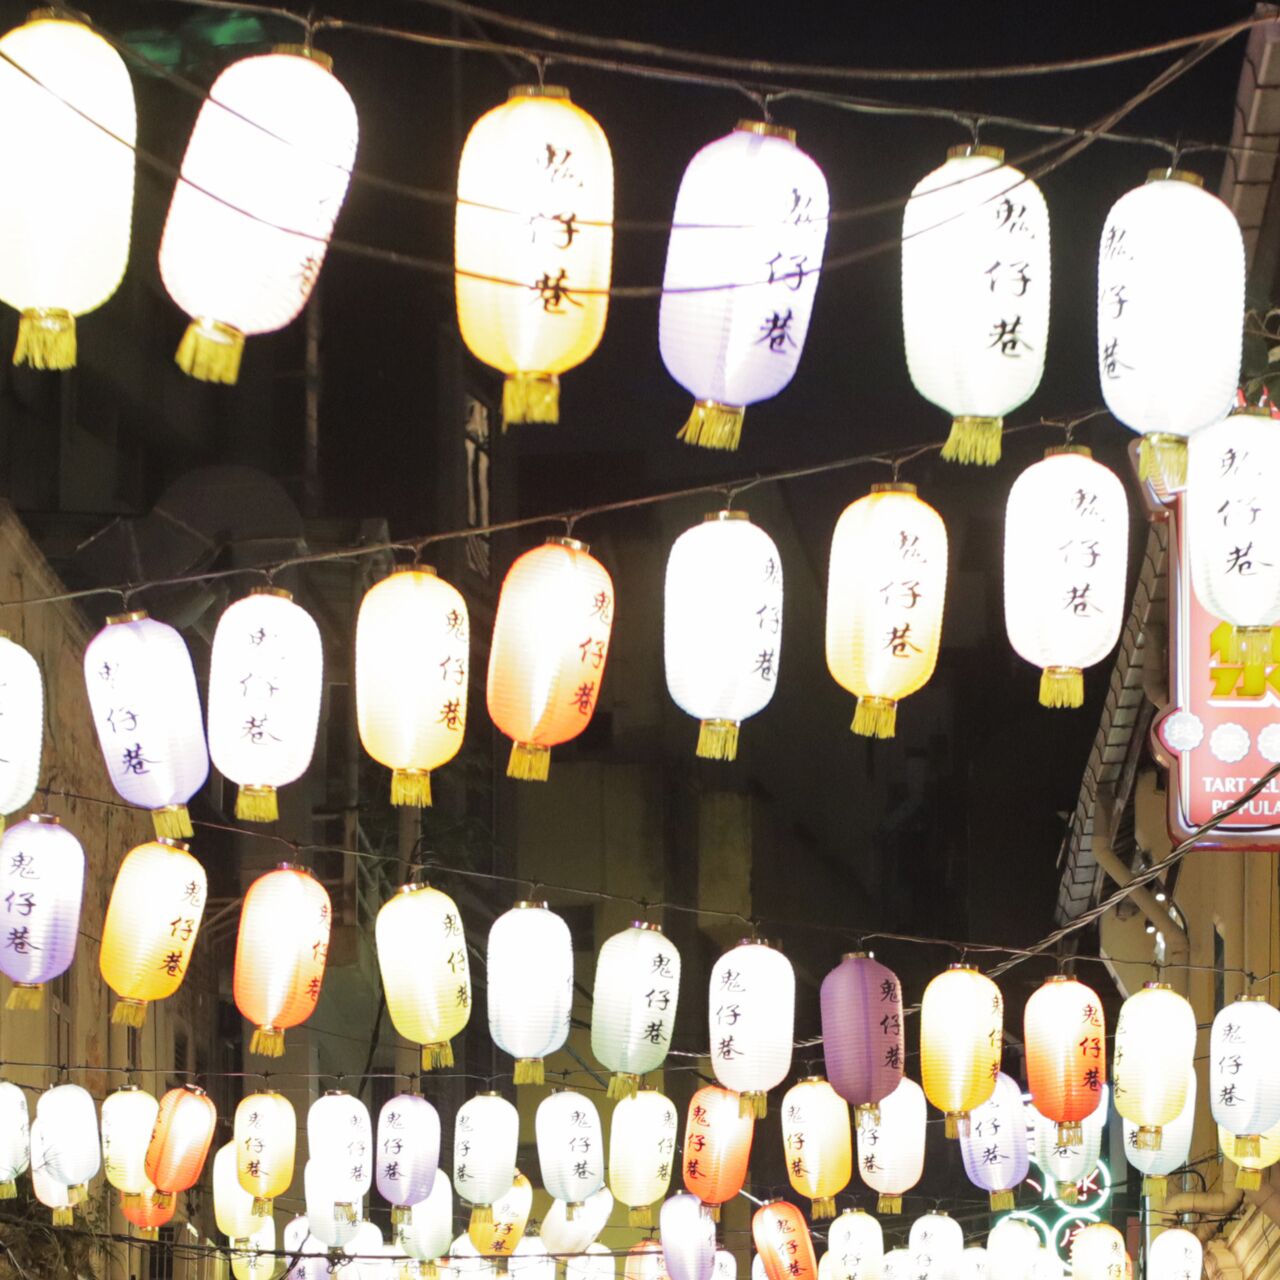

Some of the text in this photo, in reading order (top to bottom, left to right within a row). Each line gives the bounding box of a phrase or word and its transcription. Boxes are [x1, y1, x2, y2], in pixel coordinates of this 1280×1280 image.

[984, 197, 1037, 359] 鬼仔巷
[878, 530, 928, 659] 鬼仔巷
[1058, 487, 1107, 618] 鬼仔巷
[439, 608, 469, 731] 鬼仔巷
[574, 590, 614, 715] 鬼仔巷
[1202, 777, 1247, 794] TART
[3, 850, 43, 955] 鬼仔巷
[158, 879, 203, 978] 鬼仔巷
[640, 952, 674, 1045] 鬼仔巷
[714, 968, 746, 1061] 鬼仔巷
[1079, 1003, 1104, 1093] 鬼仔巷
[1218, 1022, 1246, 1108] 鬼仔巷
[383, 1111, 407, 1181] 鬼仔巷
[567, 1109, 596, 1181] 鬼仔巷
[684, 1104, 711, 1179] 鬼仔巷
